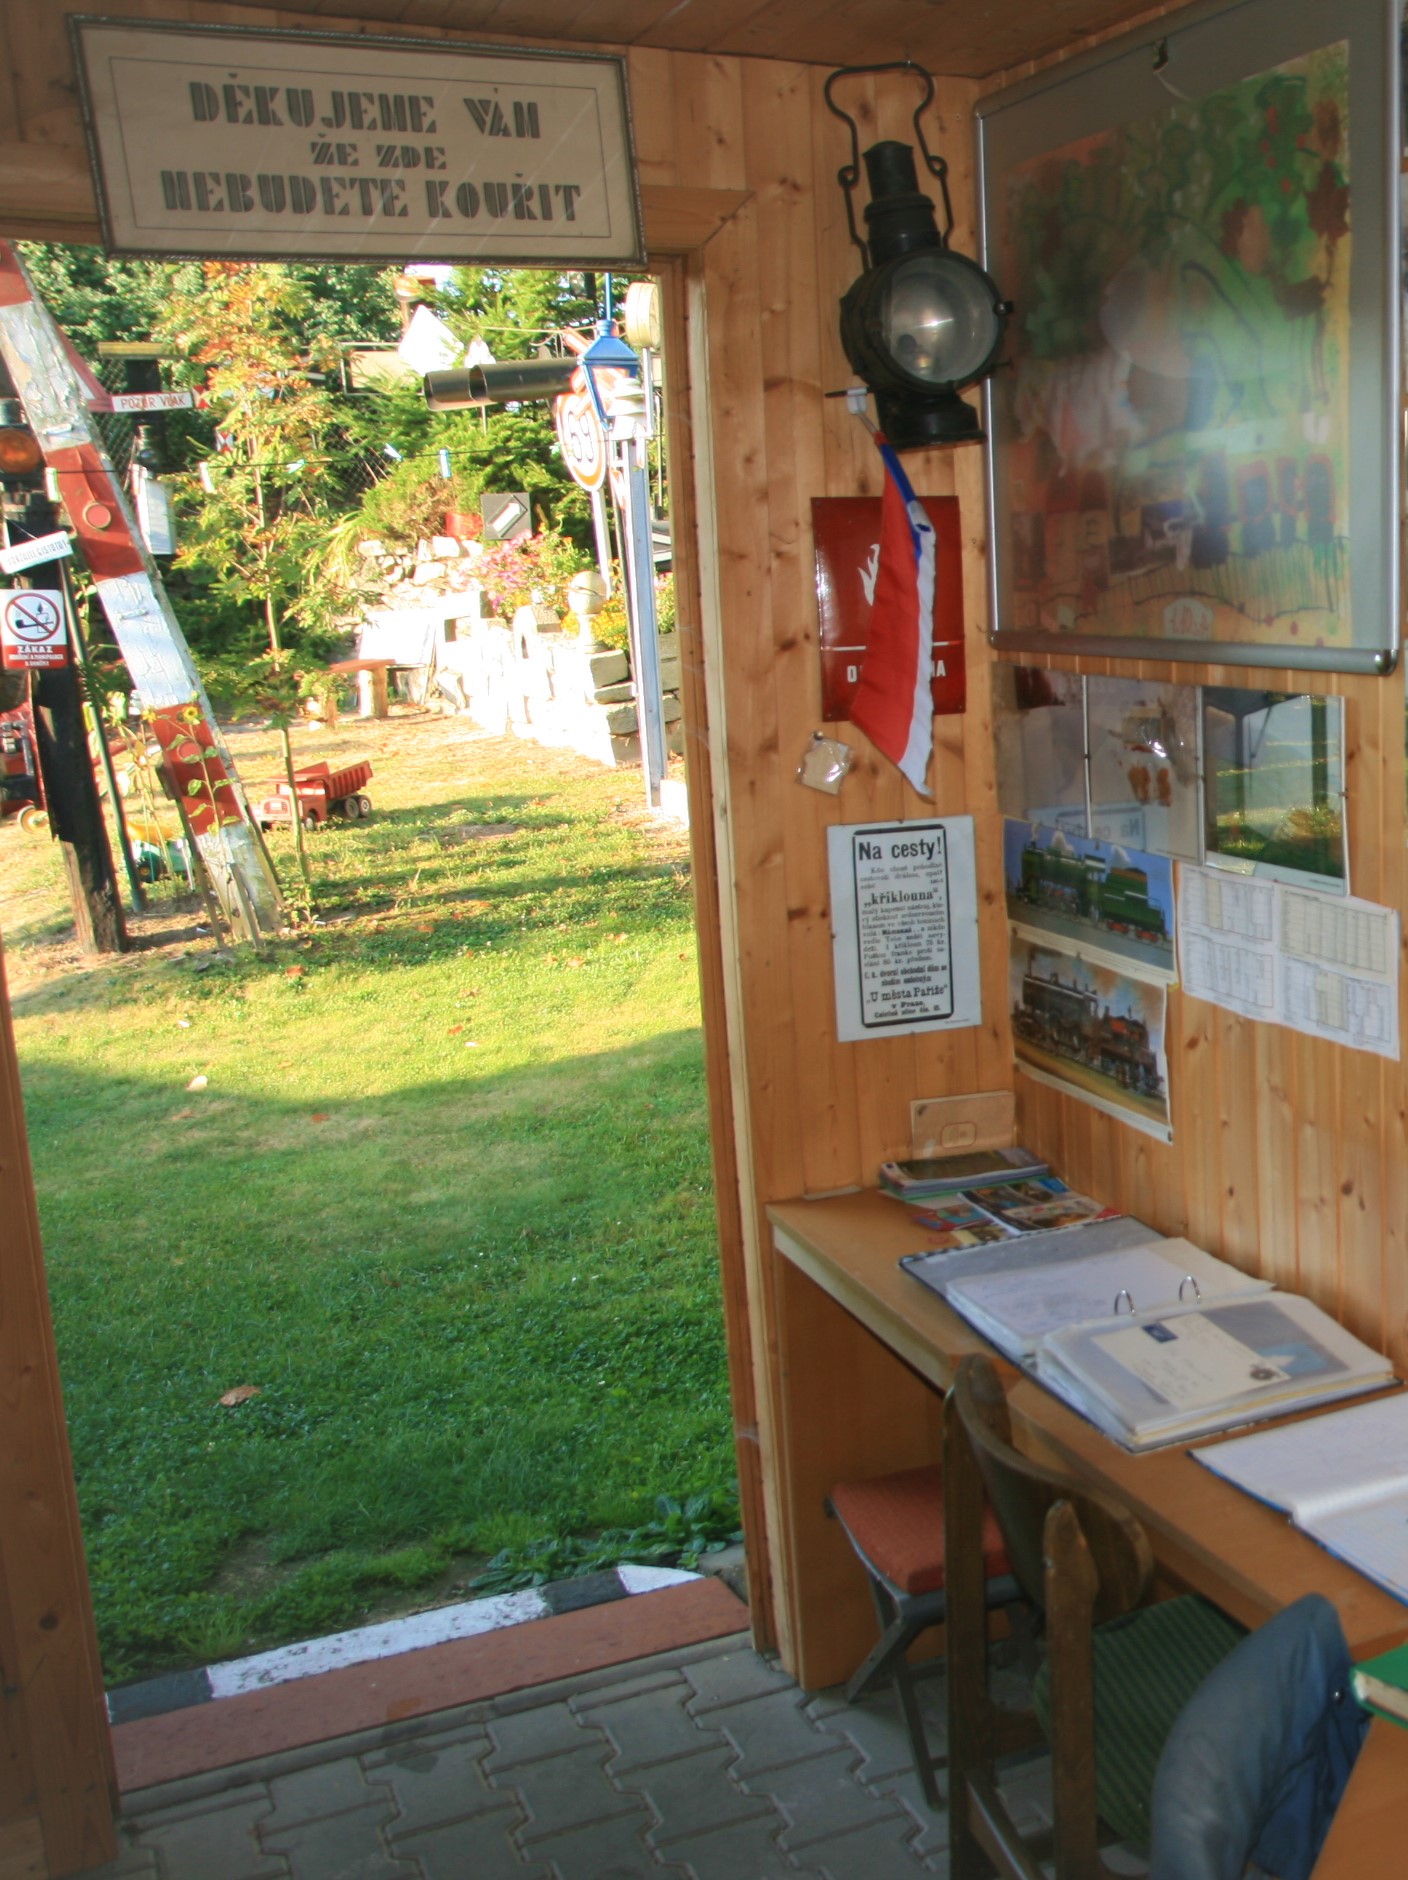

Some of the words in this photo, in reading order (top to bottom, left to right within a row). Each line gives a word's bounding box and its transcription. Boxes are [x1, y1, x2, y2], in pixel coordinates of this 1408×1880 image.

[189, 73, 437, 134] DĚKUJEME
[462, 87, 541, 139] VÁM
[310, 133, 360, 166] ŽE
[376, 144, 447, 170] ZDE
[160, 170, 409, 217] NEBUDETE
[425, 172, 581, 221] KOUŘIT
[858, 841, 882, 861] Na
[891, 836, 942, 859] cesty!
